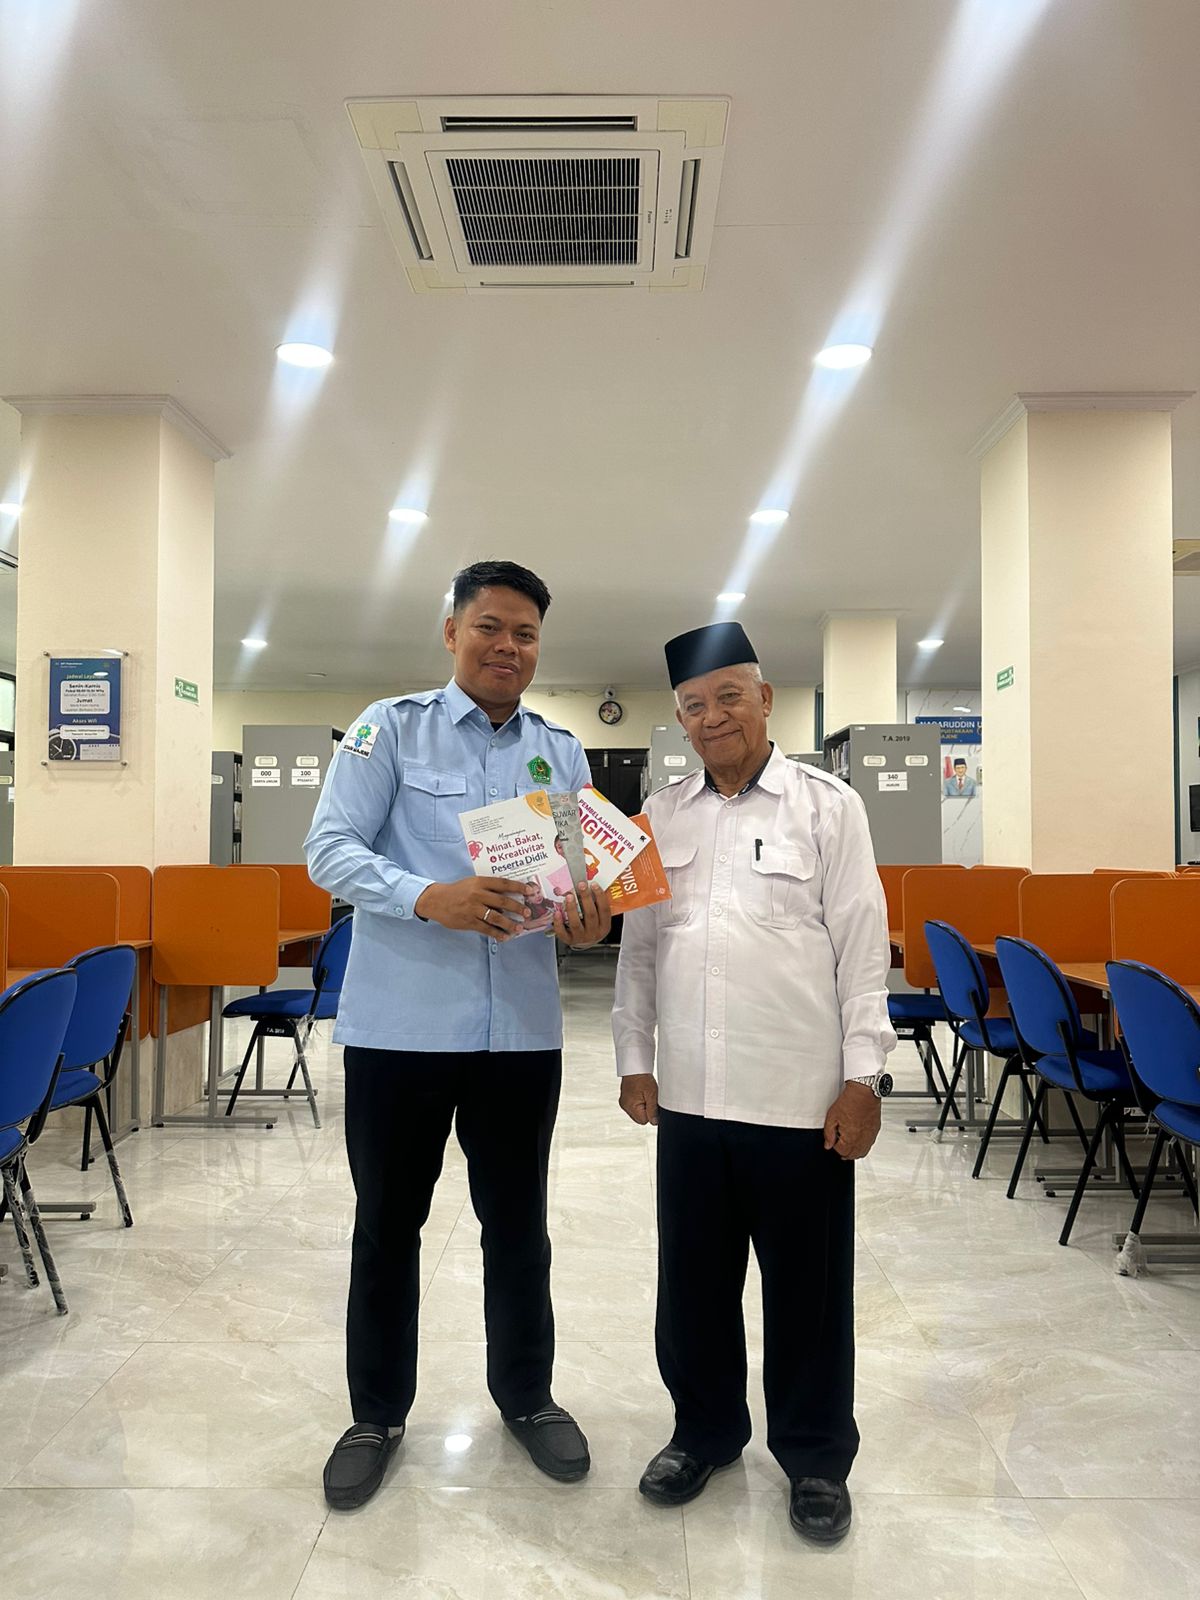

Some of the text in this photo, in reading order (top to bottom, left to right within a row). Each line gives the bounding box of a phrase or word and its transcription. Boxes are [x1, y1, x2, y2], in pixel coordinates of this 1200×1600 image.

[579, 799, 619, 836] PEMBELAJARAN
[623, 839, 635, 851] ERA
[486, 832, 543, 854] Minat, Bakat,
[497, 843, 545, 861] Kreativitas
[491, 859, 525, 874] Peserta
[525, 852, 549, 865] Didik
